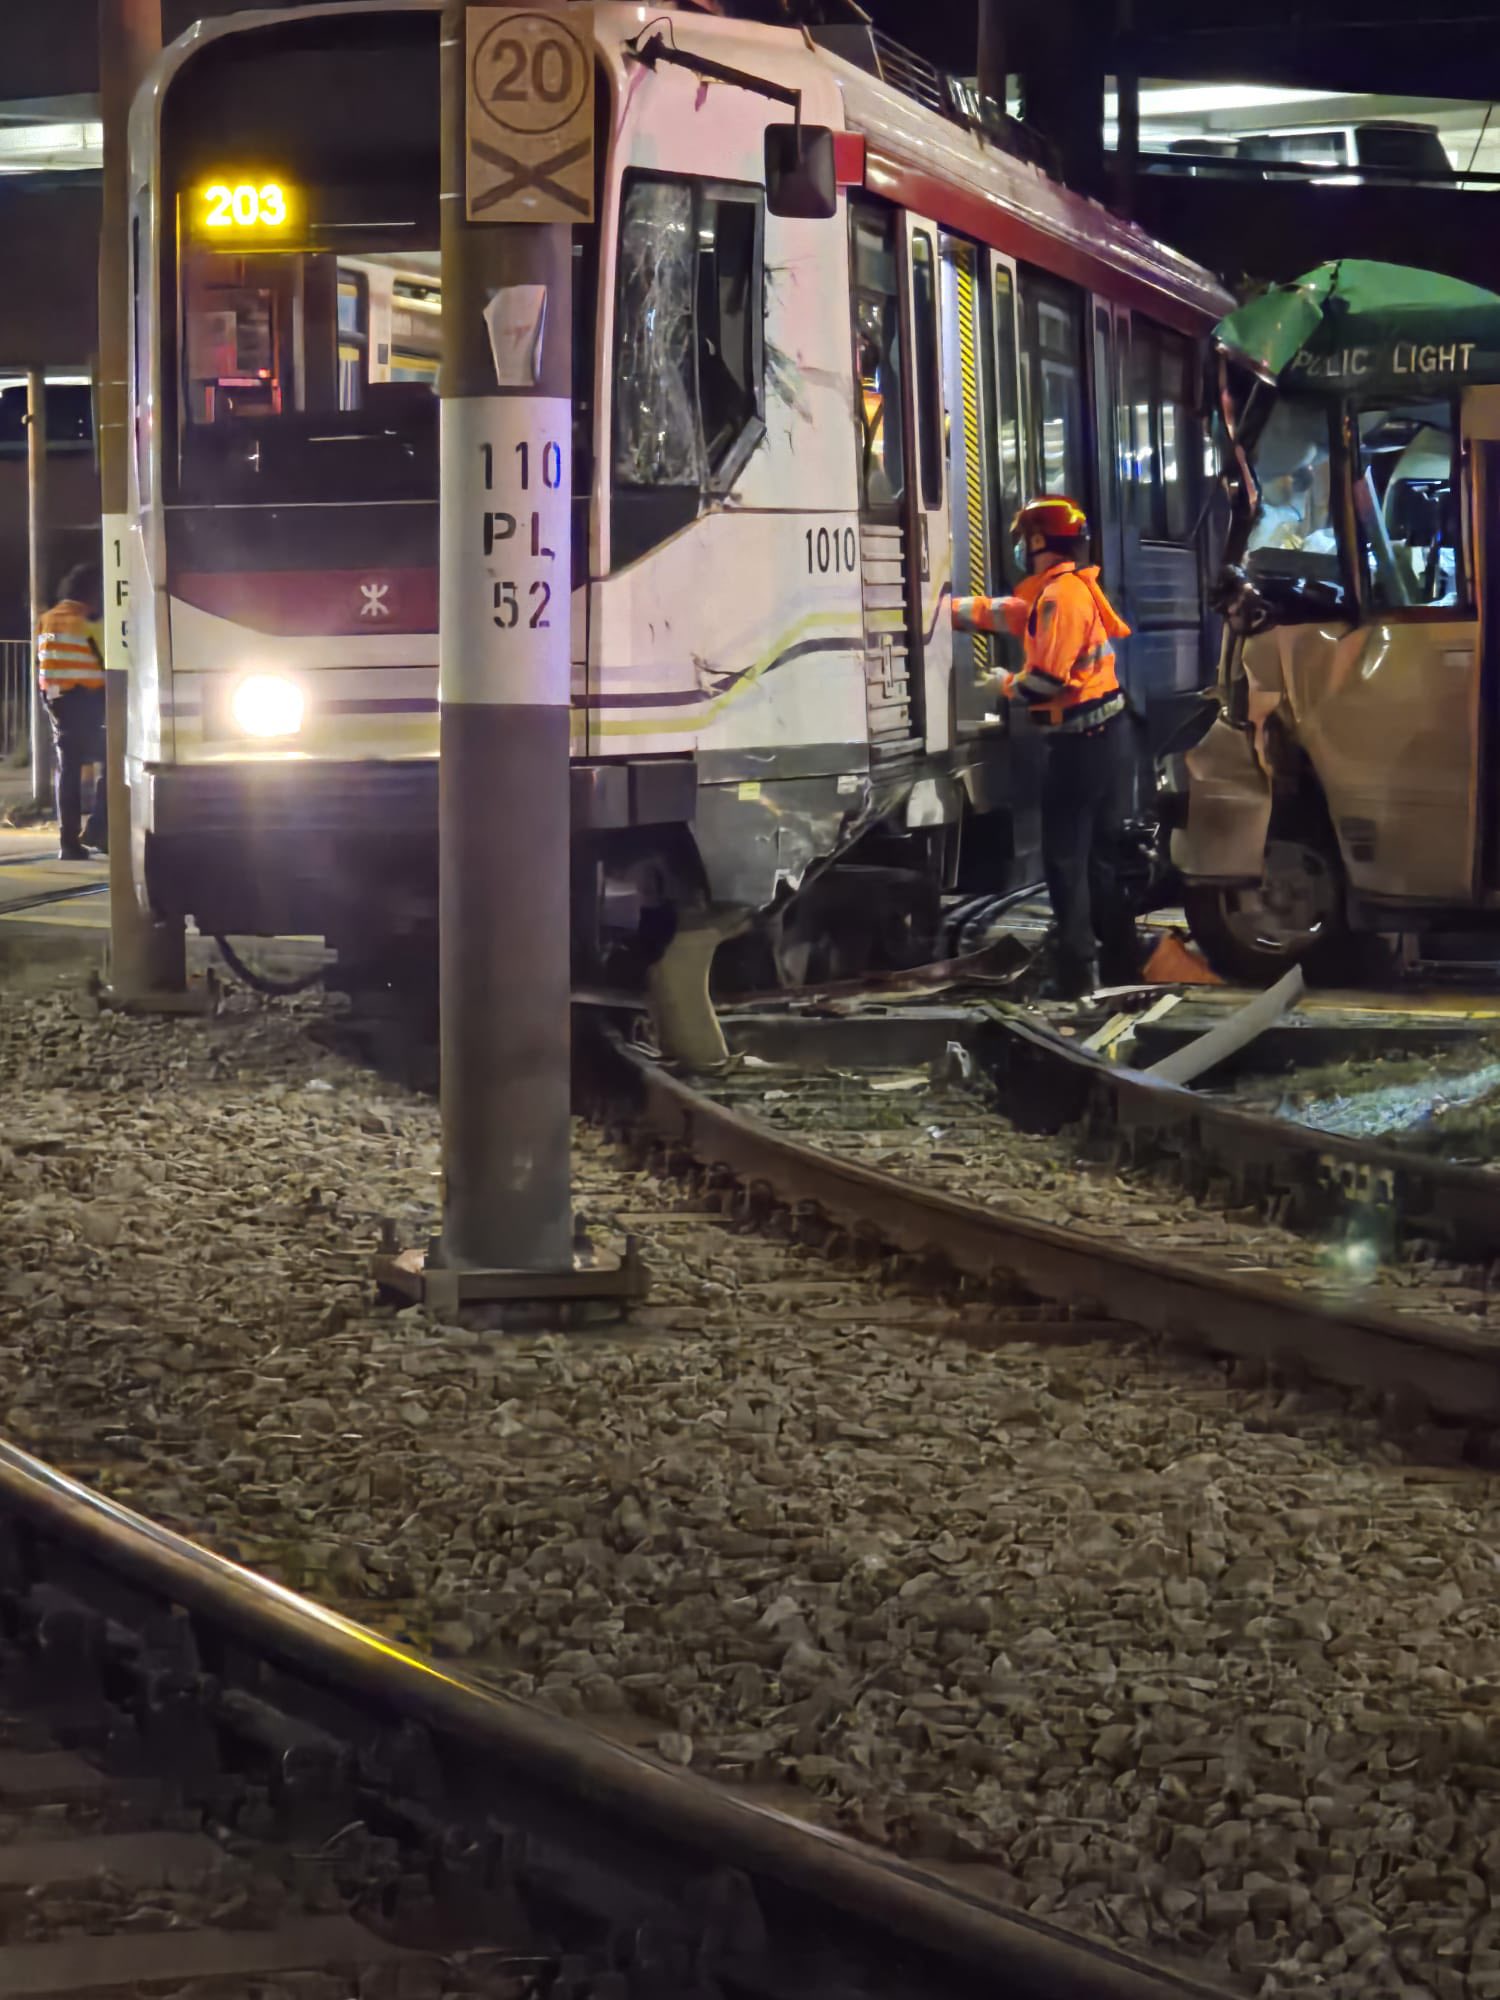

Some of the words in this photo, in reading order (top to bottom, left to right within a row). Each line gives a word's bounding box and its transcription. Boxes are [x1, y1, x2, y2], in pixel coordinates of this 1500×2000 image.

[490, 39, 572, 103] 20
[204, 184, 287, 226] 203
[1392, 343, 1476, 374] LIGHT
[480, 441, 562, 490] 110
[483, 512, 555, 560] PL
[805, 526, 856, 574] 1010
[493, 581, 551, 628] 52
